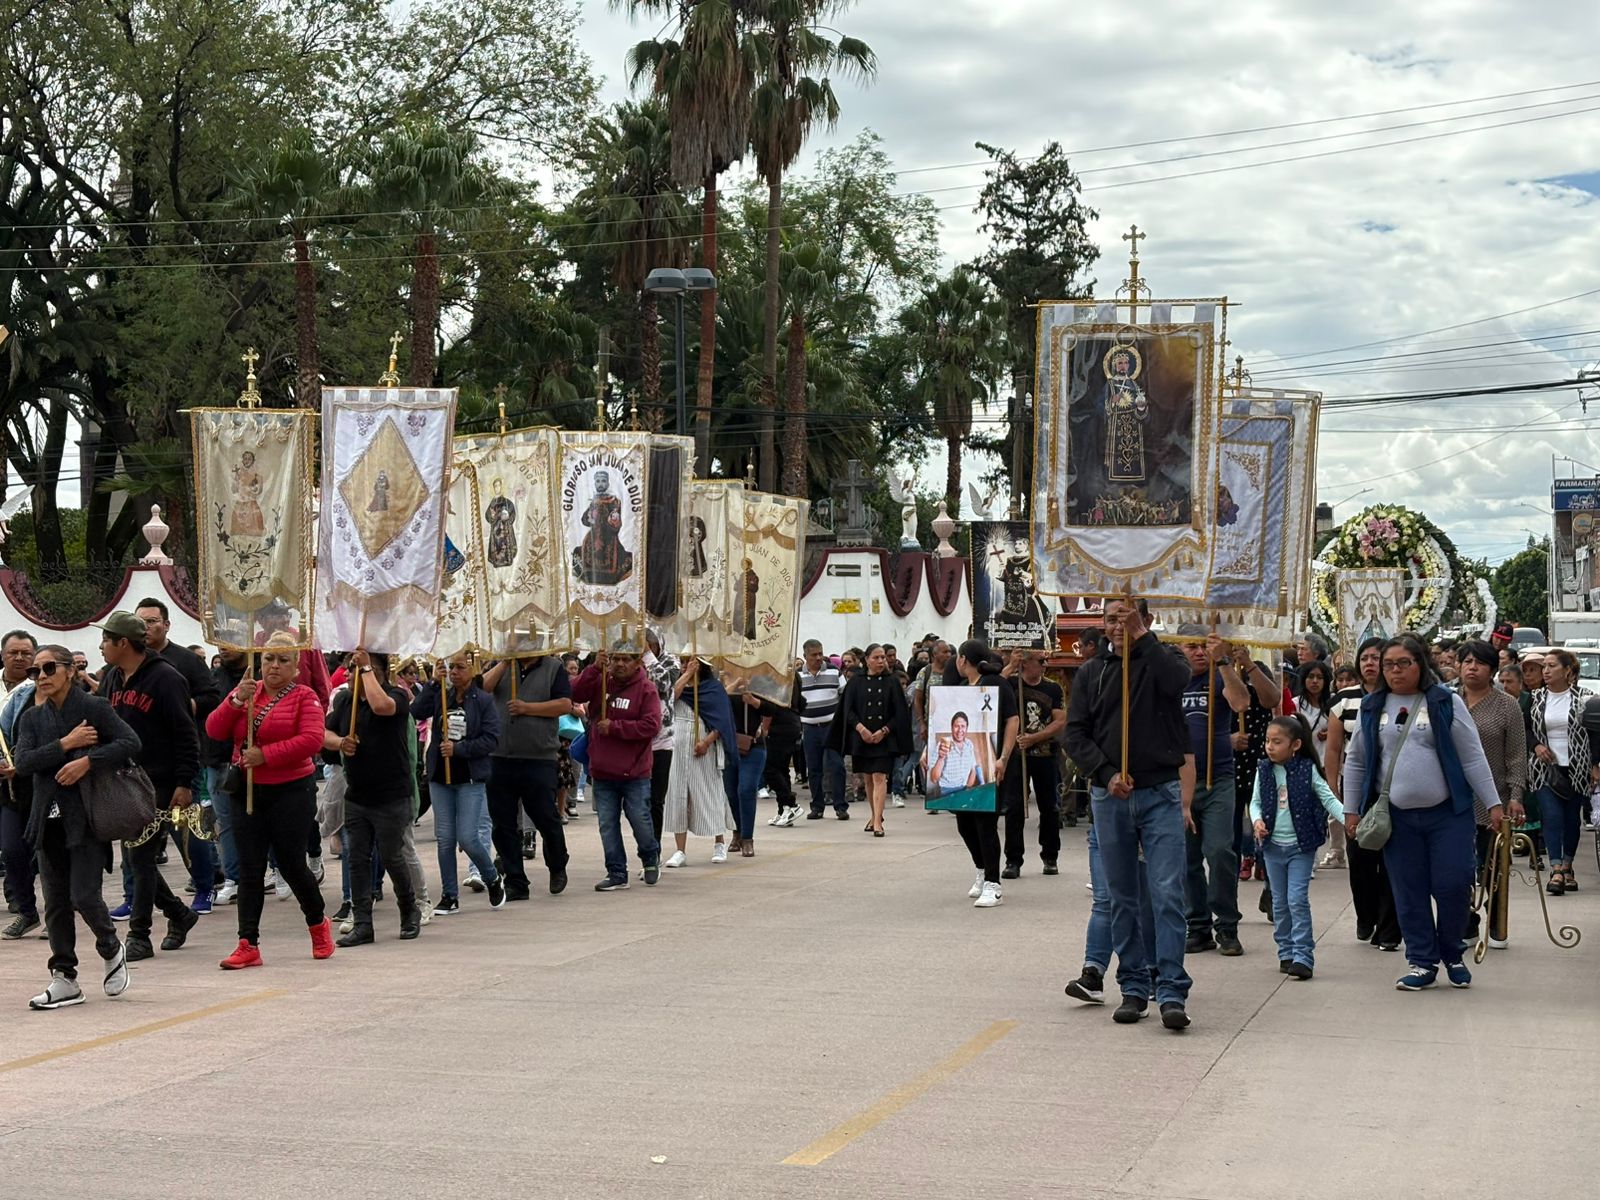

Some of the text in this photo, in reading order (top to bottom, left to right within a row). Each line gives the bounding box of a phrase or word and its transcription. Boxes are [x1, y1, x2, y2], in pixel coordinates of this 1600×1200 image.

[519, 465, 538, 486] DIOS
[622, 468, 634, 486] DE
[628, 485, 642, 513] DIOS
[749, 544, 769, 558] JUAN
[770, 555, 780, 567] DE
[780, 567, 793, 587] DIOS
[1181, 696, 1208, 708] VI'S
